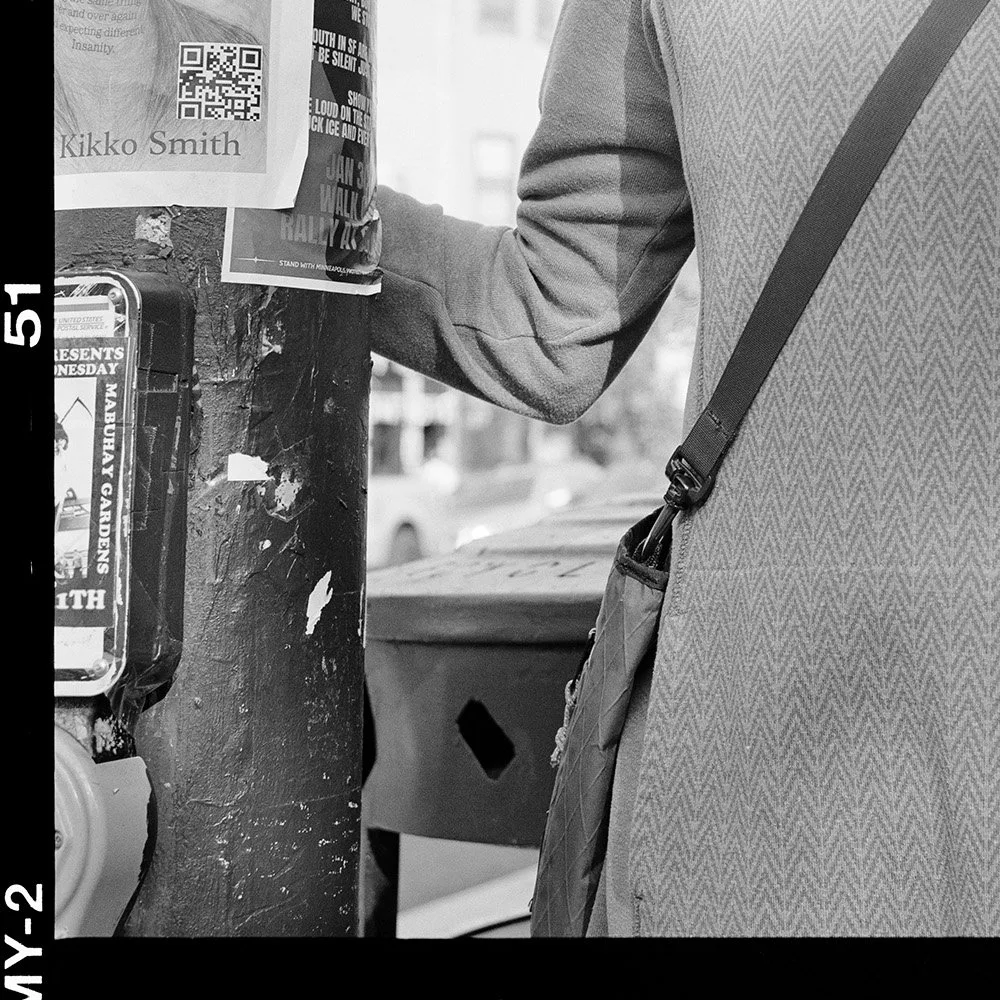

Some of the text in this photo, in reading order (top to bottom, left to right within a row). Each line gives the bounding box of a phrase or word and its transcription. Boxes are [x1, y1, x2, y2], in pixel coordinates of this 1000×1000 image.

[68, 9, 85, 19] and
[87, 12, 109, 21] over
[111, 13, 137, 23] again
[60, 23, 102, 39] expecting
[313, 28, 336, 48] OUTH
[338, 34, 346, 51] IN
[348, 38, 357, 55] SF
[72, 38, 115, 55] Insanity.
[318, 46, 330, 64] BE
[332, 50, 357, 72] SILENT
[315, 99, 339, 119] LOUD
[341, 105, 351, 122] ON
[353, 108, 363, 128] THE
[325, 118, 340, 137] ICE
[342, 123, 357, 142] AND
[59, 130, 241, 159] Kikko Smith
[326, 154, 354, 186] JAN
[280, 211, 340, 247] RALLY
[279, 260, 299, 268] STAND
[300, 261, 315, 269] WITH
[4, 283, 42, 348] 51
[97, 383, 117, 575] MABUHAY GARDENS
